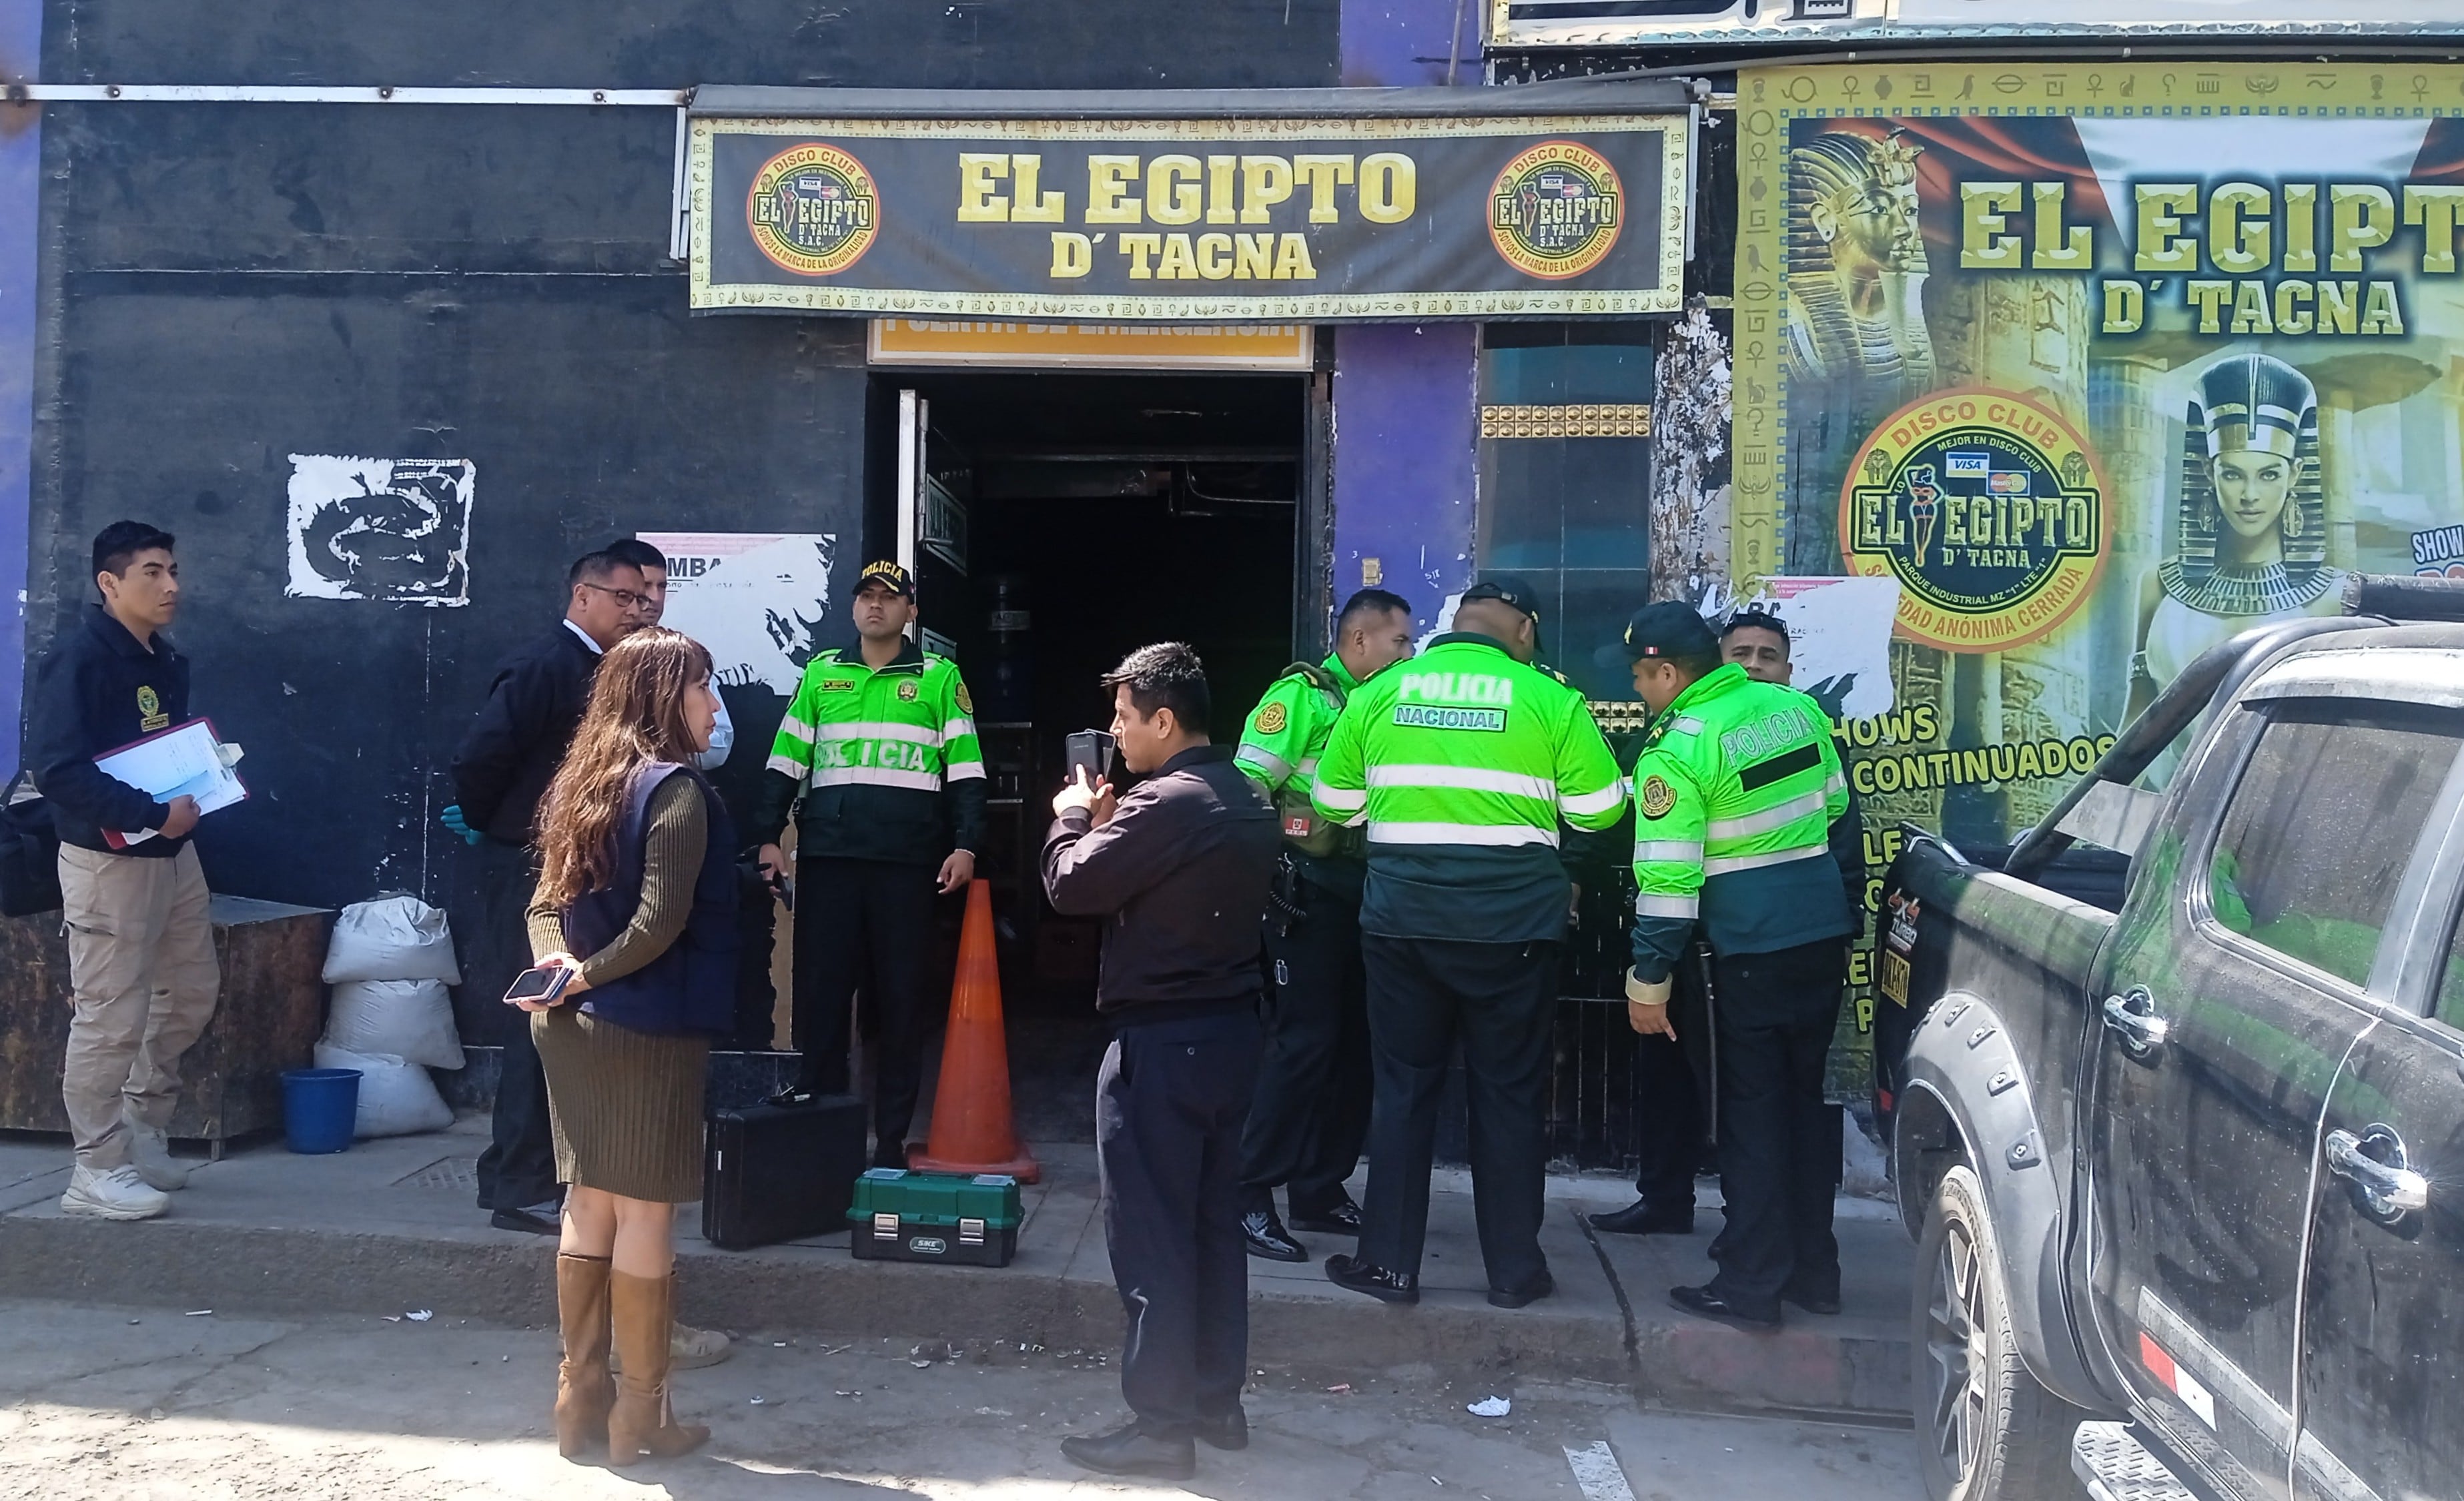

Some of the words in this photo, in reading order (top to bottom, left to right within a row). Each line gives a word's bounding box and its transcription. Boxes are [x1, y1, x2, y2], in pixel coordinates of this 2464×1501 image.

[773, 149, 816, 172] DISCO
[821, 151, 856, 175] CLUB
[1514, 147, 1558, 173] DISCO
[1564, 148, 1600, 172] CLUB
[958, 153, 1064, 223] EL
[1085, 153, 1416, 223] EGIPTO
[759, 197, 781, 222] EL
[799, 197, 868, 225] EGIPTO
[1499, 199, 1521, 225] EL
[1539, 197, 1612, 224] EGIPTO
[1960, 181, 2092, 269] EL
[799, 235, 824, 246] S.A.C.
[811, 224, 841, 236] TACNA
[1540, 237, 1567, 247] S.A.C.
[1552, 224, 1584, 236] TACNA
[757, 227, 774, 249] SOMOS
[773, 245, 781, 257] LA
[781, 252, 805, 268] MARCA
[807, 260, 816, 268] DE
[818, 258, 827, 268] LA
[828, 231, 867, 267] ORIGINALIDAD
[1120, 233, 1316, 280] TACNA
[1498, 231, 1515, 255] SOMOS
[1514, 250, 1523, 262] LA
[1524, 256, 1547, 272] MARCA
[1549, 264, 1558, 272] DE
[1561, 261, 1570, 272] LA
[1571, 229, 1611, 268] ORIGINALIDAD
[2186, 280, 2403, 334] TACNA
[1891, 402, 1976, 448] DISCO
[1988, 404, 2059, 449] CLUB
[1895, 481, 1906, 494] LO
[1937, 436, 1971, 452] MEJOR
[1974, 436, 1986, 445] EN
[1989, 438, 2019, 456] DISCO
[2019, 452, 2042, 472] CLUB
[1954, 460, 1982, 470] VISA
[1862, 496, 1905, 545] EL
[1944, 495, 2087, 547] EGIPTO
[861, 560, 903, 582] POLICIA
[1968, 549, 2031, 568] TACNA
[1899, 556, 1931, 592] PARQUE
[1930, 586, 1989, 604] INDUSTRIAL
[1990, 592, 2006, 602] MZ
[2021, 572, 2038, 588] LTE
[1934, 616, 2017, 638] ANÓNIMA
[2018, 567, 2084, 627] CERRADA
[1398, 672, 1513, 705] POLICIA
[1396, 707, 1500, 728] NACIONAL
[1829, 707, 1936, 746] HOWS
[1720, 706, 1816, 769] POLICIA
[1892, 917, 1918, 945] TURBO
